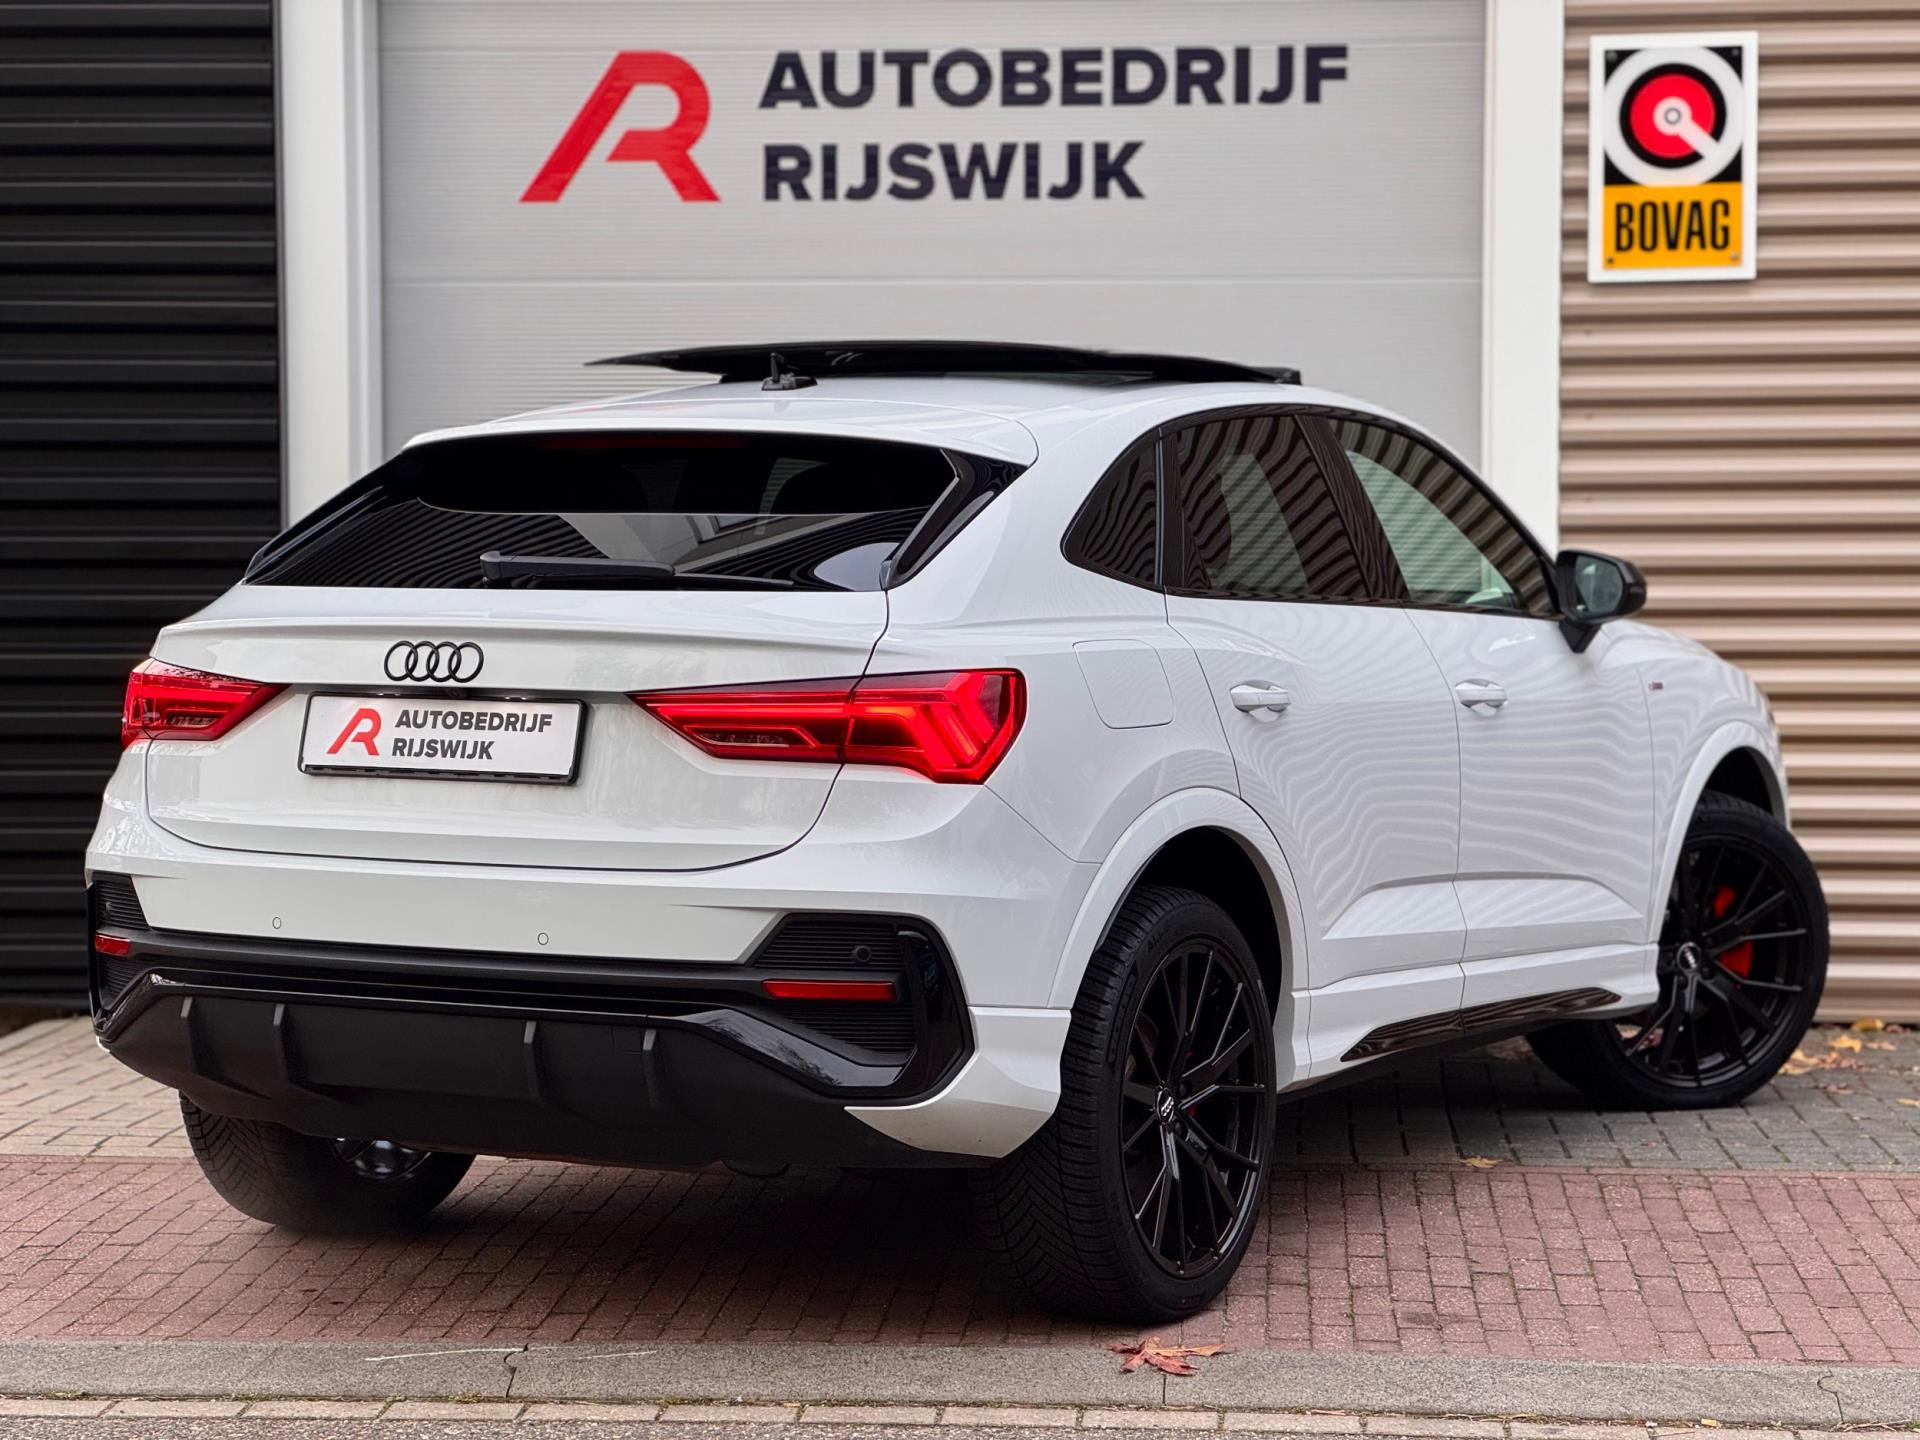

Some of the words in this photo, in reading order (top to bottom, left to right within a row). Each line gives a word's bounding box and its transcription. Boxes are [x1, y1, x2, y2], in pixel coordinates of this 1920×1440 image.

[759, 45, 1348, 109] AUTOBEDRIJF
[763, 141, 1144, 201] RIJSWIJK
[1613, 198, 1731, 254] BOVAG
[391, 737, 495, 760] RIJSWIJK
[395, 709, 553, 734] AUTOBEDRIJF
